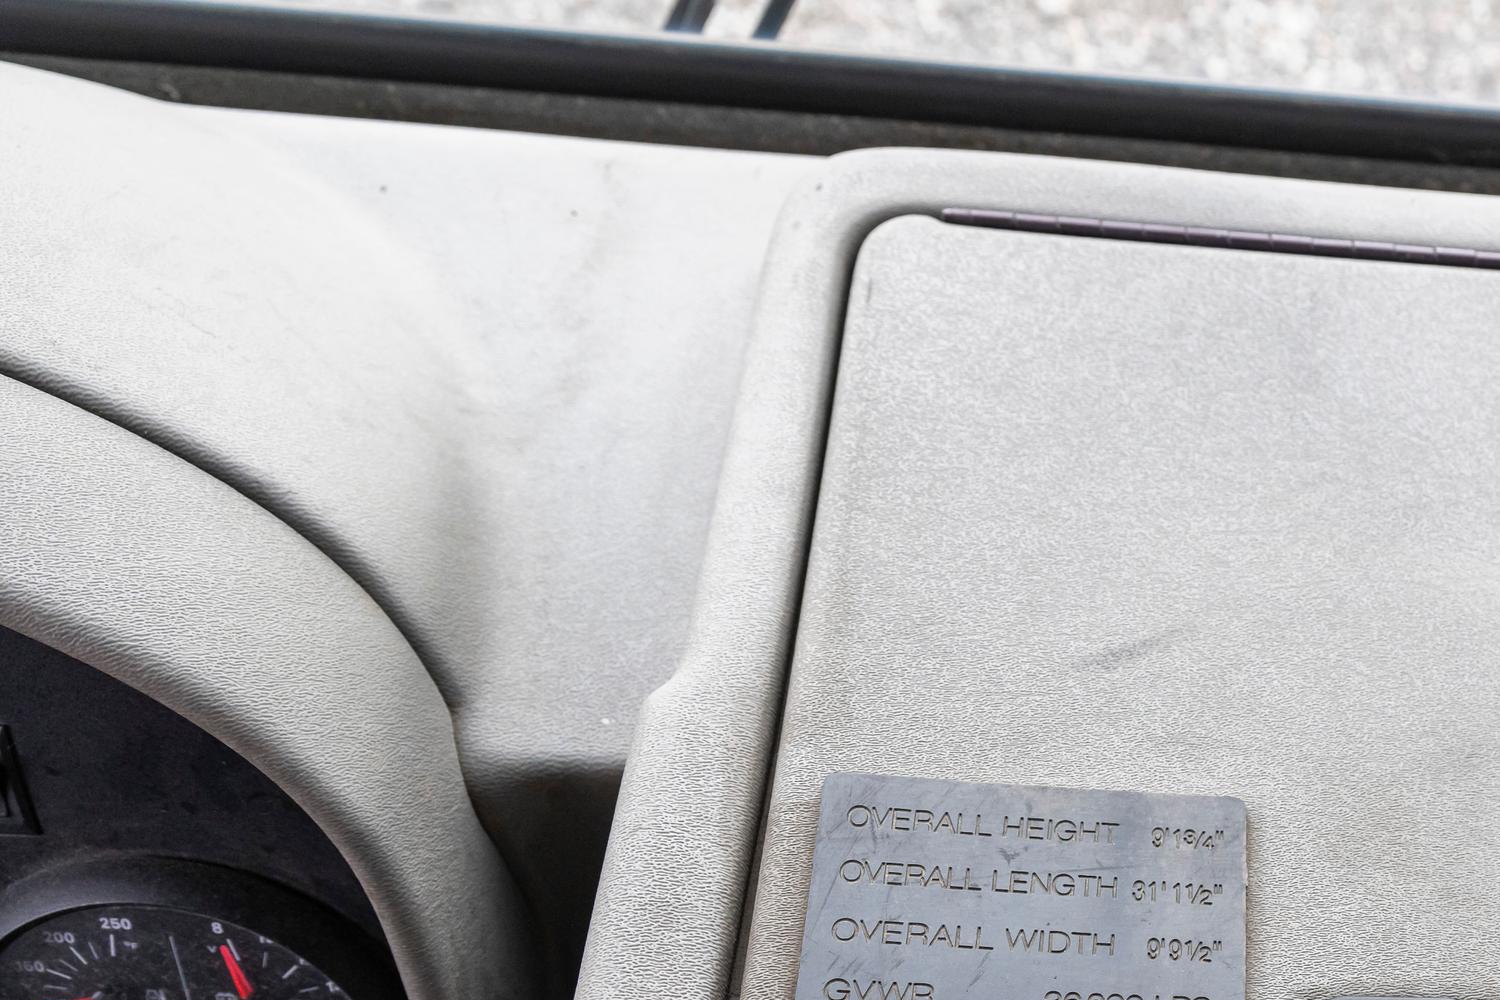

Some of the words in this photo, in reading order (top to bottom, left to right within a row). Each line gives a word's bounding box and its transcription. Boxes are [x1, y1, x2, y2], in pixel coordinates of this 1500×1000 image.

[847, 804, 992, 837] OVERALL
[1002, 815, 1120, 844] HEIGHT
[839, 859, 981, 892] OVERALL
[992, 868, 1118, 898] LENGTH
[100, 917, 132, 930] 250
[211, 921, 224, 935] 8
[831, 917, 994, 951] OVERALL
[1005, 927, 1116, 956] WIDTH
[43, 931, 75, 943] 200
